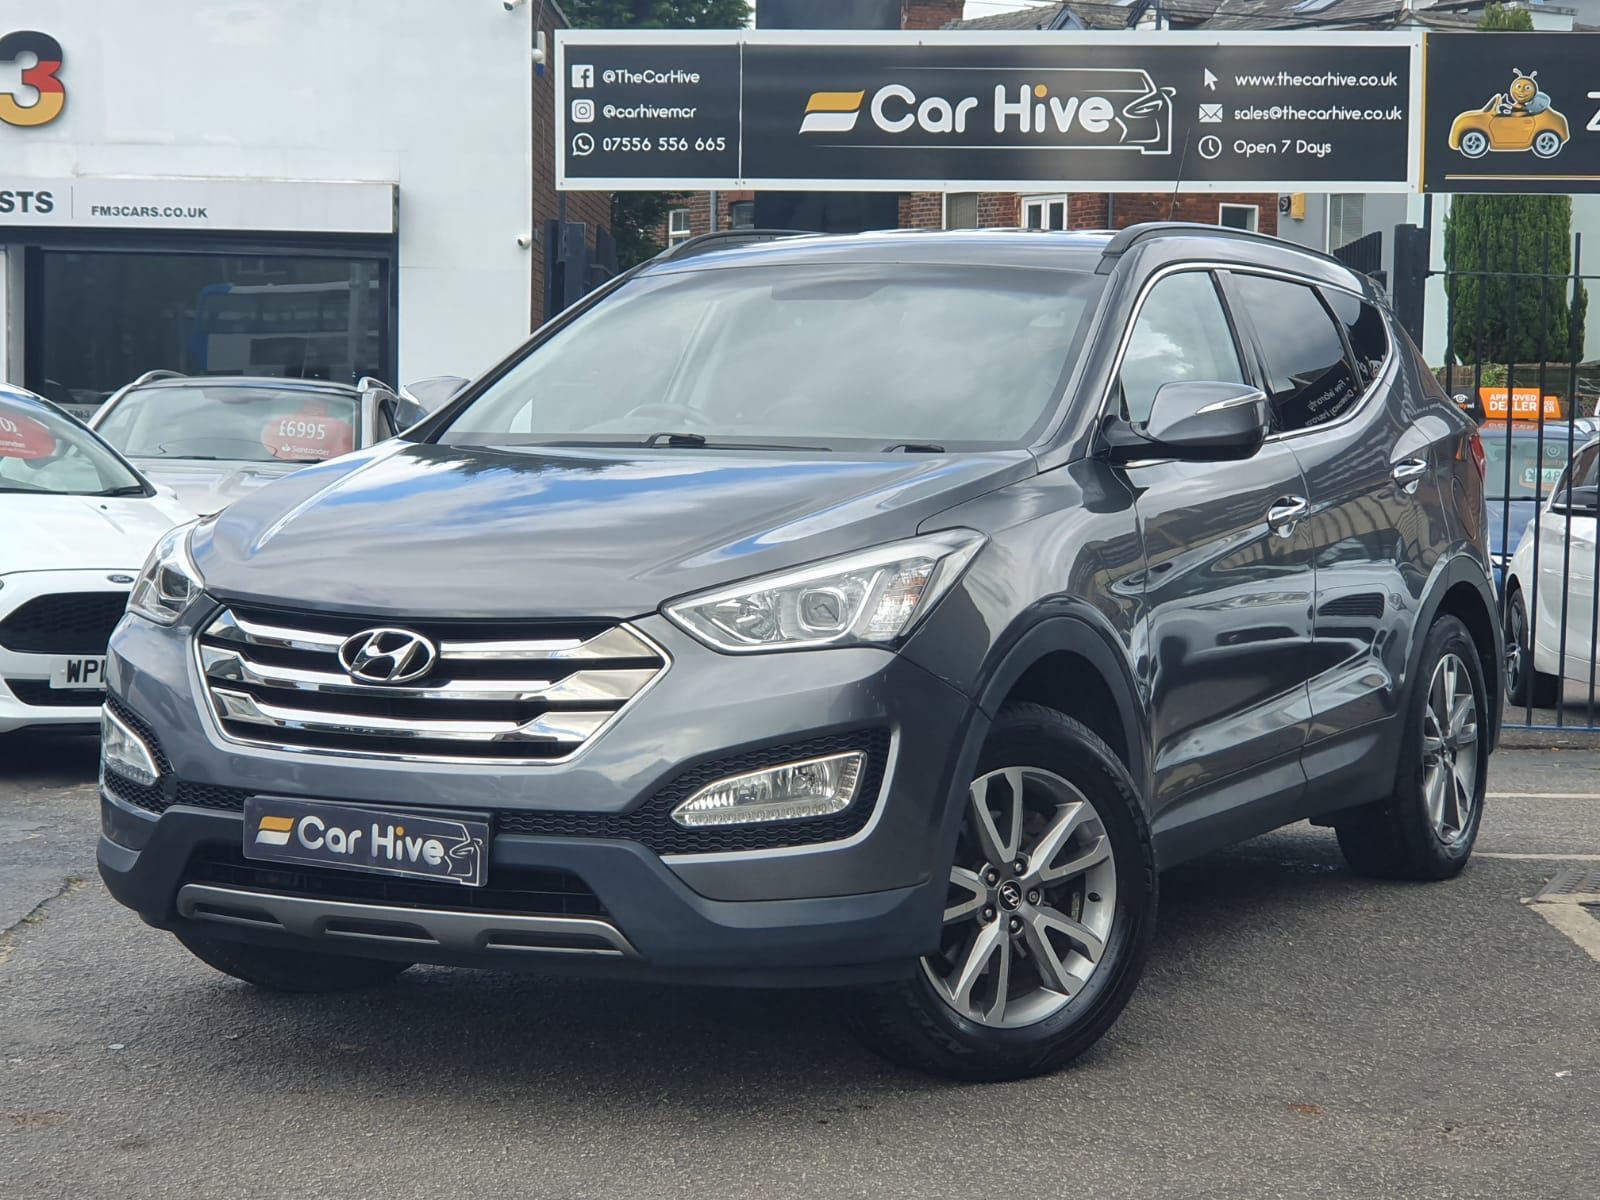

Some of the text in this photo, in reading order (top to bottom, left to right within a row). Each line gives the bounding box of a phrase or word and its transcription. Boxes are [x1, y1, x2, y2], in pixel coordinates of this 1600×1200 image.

[0, 30, 65, 127] 3
[602, 69, 700, 84] @TheCarHive
[1234, 72, 1398, 87] www.thecarhive.co.uk
[602, 104, 696, 119] @carhivemcr
[871, 84, 1114, 133] Car Hive
[1234, 105, 1402, 121] sales@thecarhive.co.uk
[602, 137, 726, 151] 07556 556 665
[1233, 140, 1332, 158] Open 7 Days
[91, 206, 208, 218] FM3CARS.CO.UK
[279, 420, 326, 440] £6995
[297, 815, 445, 866] Car Hive
